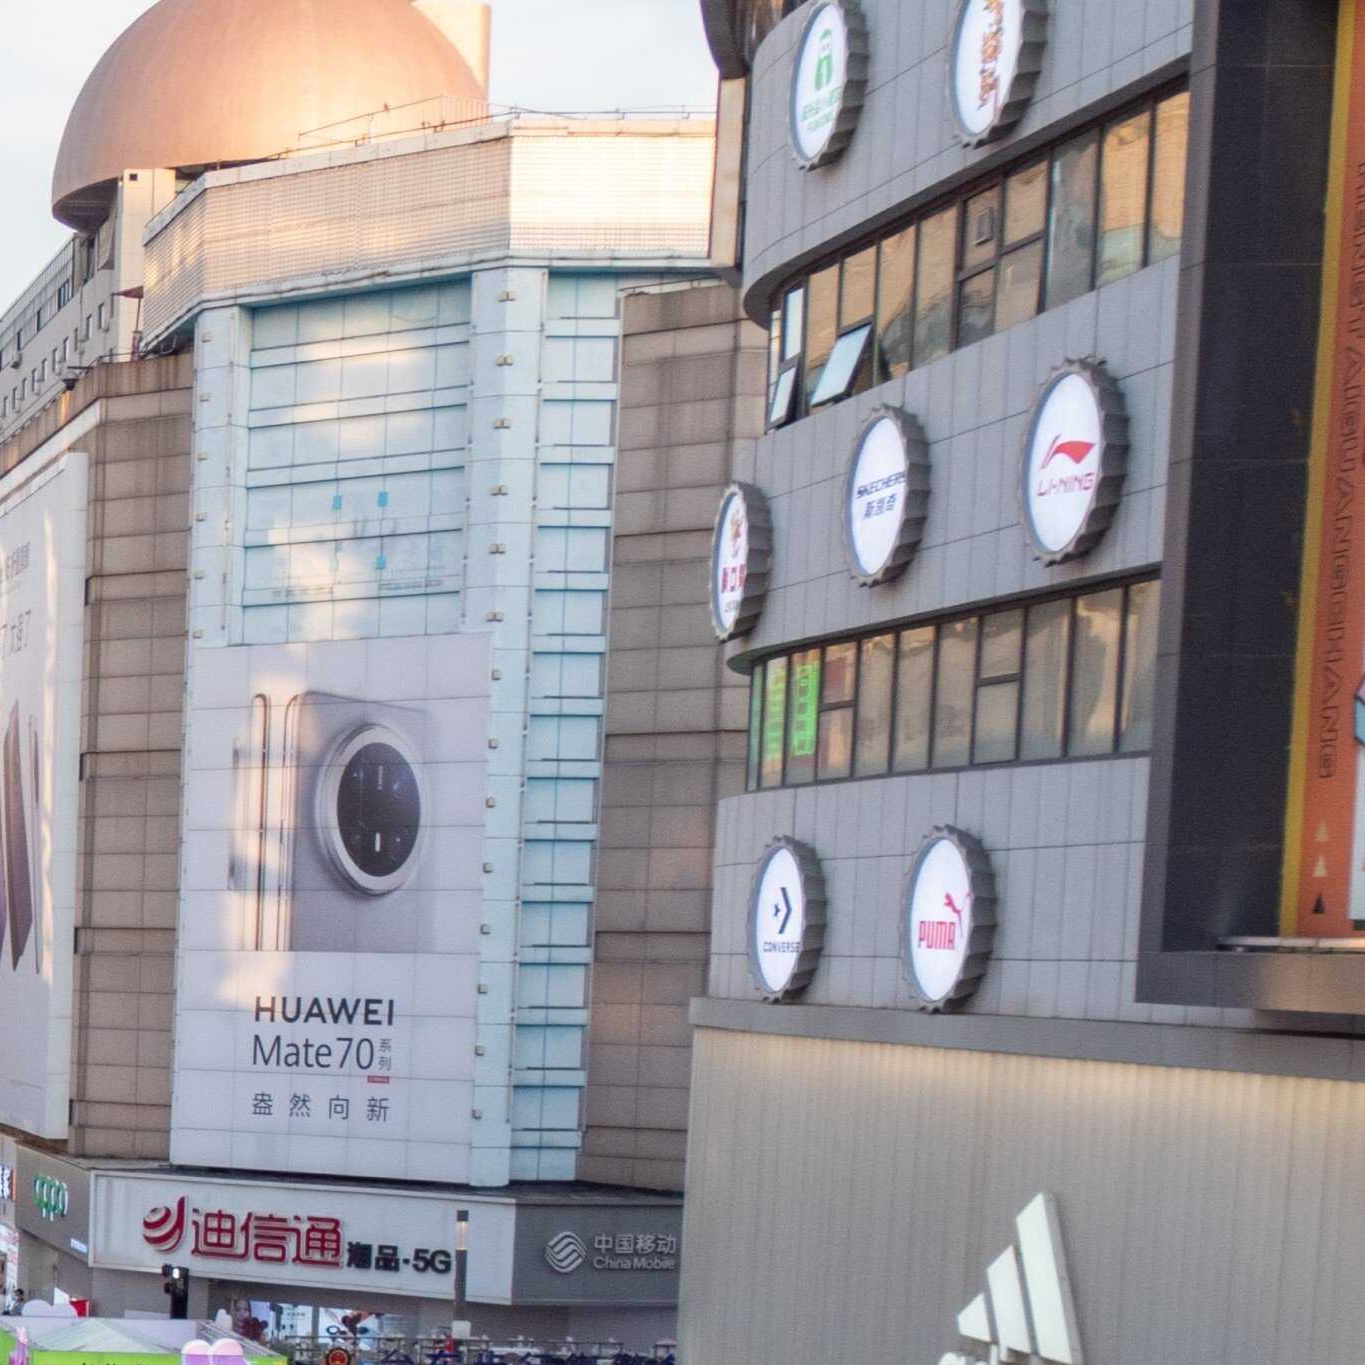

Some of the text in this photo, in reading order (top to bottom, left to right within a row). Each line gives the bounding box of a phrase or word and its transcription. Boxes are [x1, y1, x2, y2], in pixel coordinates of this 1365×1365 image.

[918, 919, 955, 950] PUMA
[254, 996, 394, 1026] HUAWEI
[252, 1091, 391, 1122] 盎然向新
[191, 1207, 344, 1268] 迪信通
[594, 1233, 677, 1255] 中国移动
[593, 1256, 631, 1270] China
